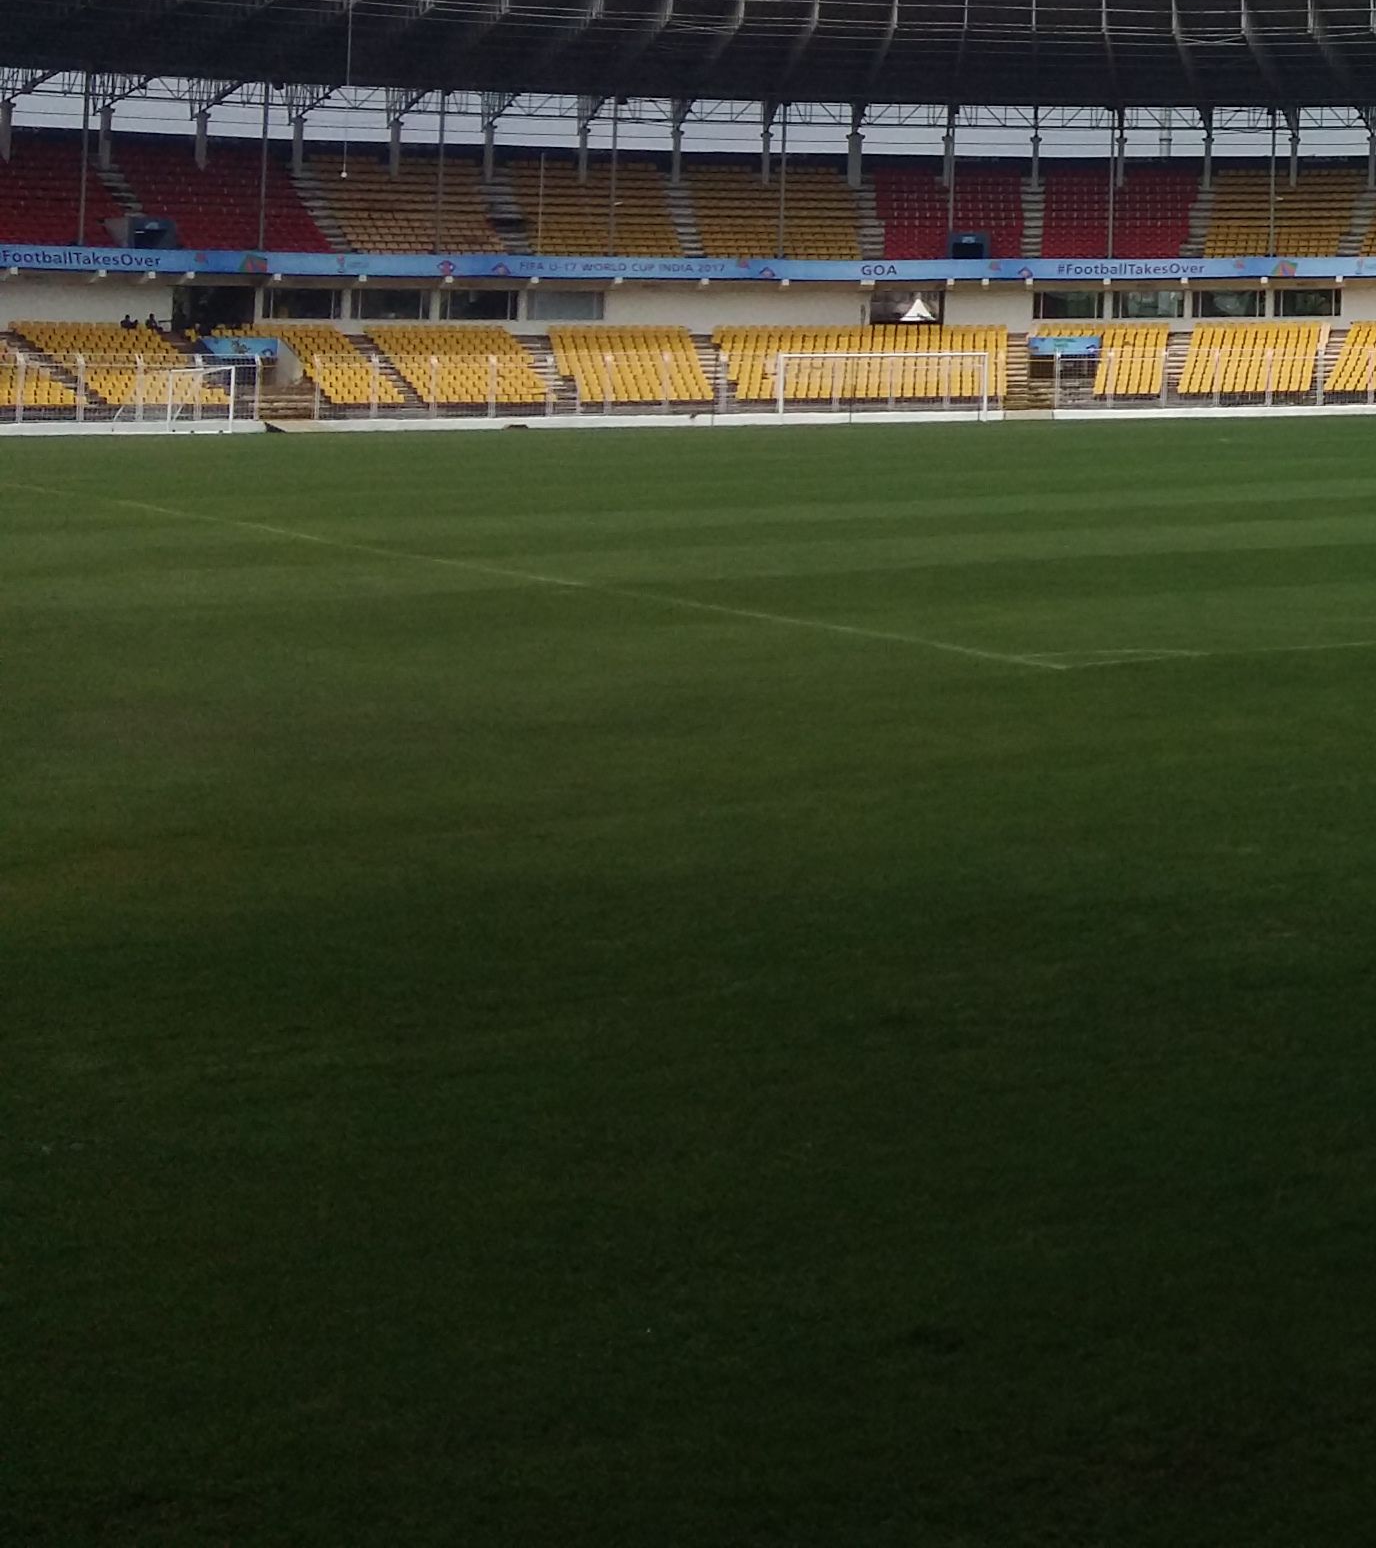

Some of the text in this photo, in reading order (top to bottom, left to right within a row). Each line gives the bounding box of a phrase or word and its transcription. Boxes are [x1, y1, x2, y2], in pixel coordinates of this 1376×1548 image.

[0, 250, 161, 267] FootballTakesOver
[520, 261, 545, 272] FIFA
[582, 263, 627, 272] WORLD
[632, 263, 655, 272] CUP
[658, 263, 694, 272] INDIA
[698, 264, 725, 273] 2017
[860, 264, 898, 276] GOA
[1057, 262, 1205, 275] #FootballTakesOver
